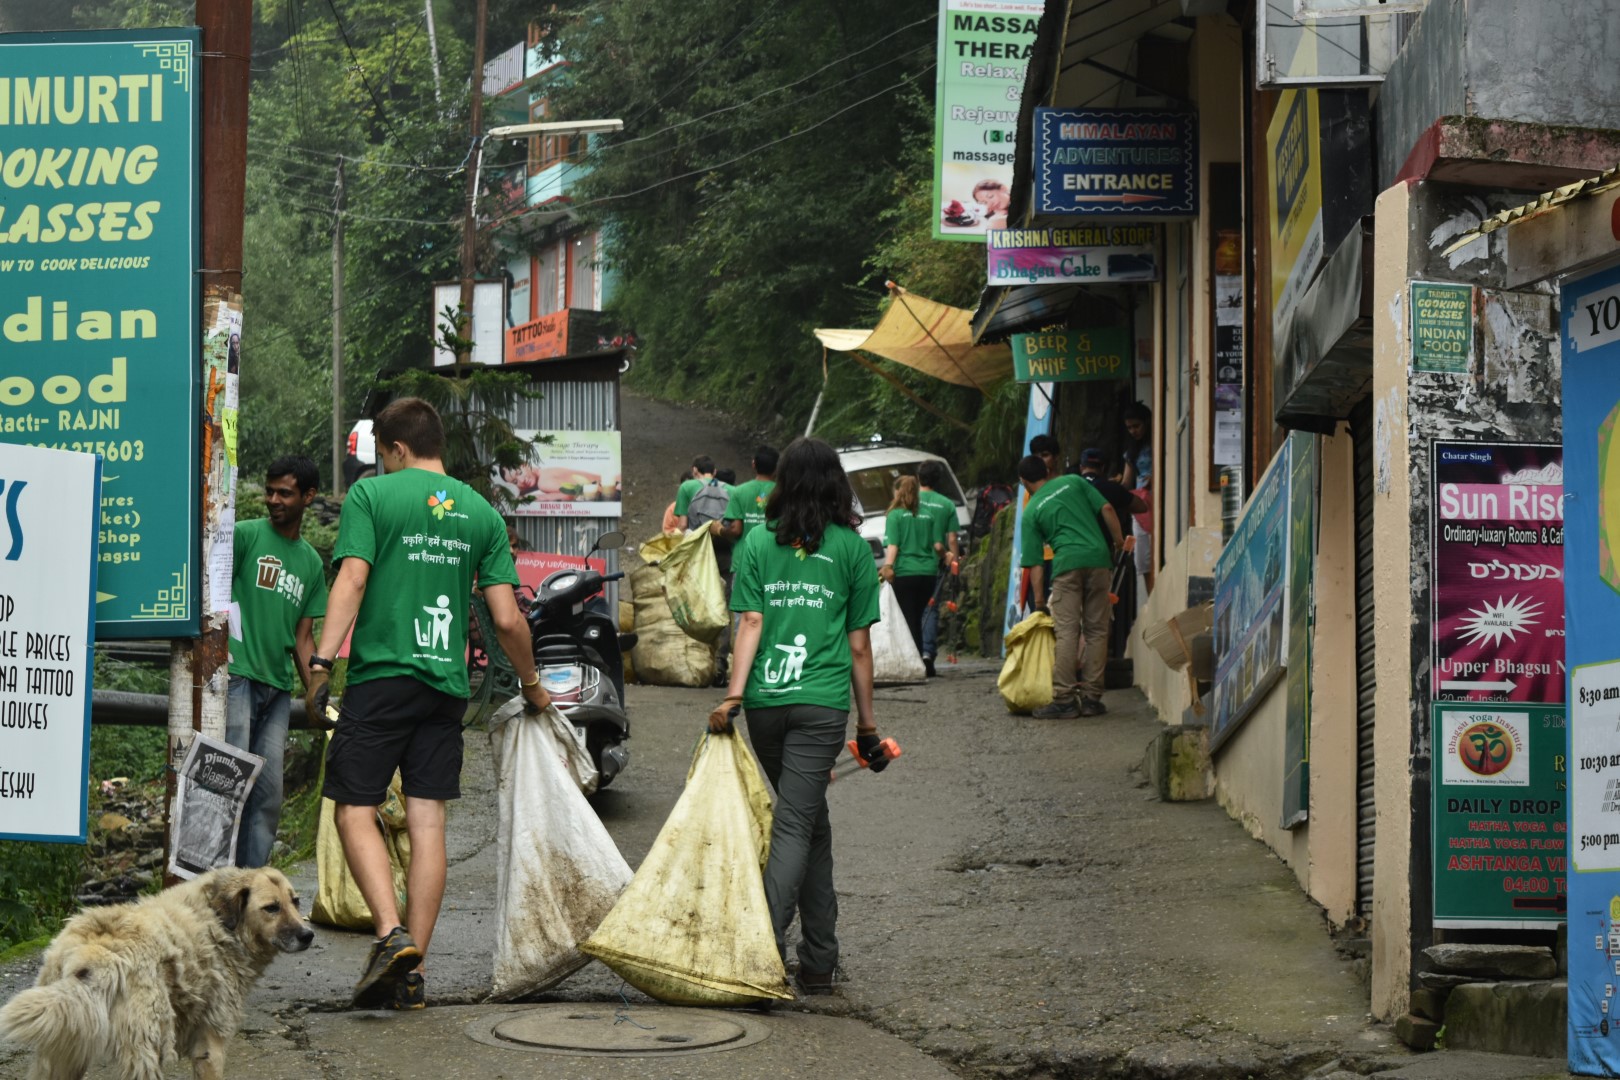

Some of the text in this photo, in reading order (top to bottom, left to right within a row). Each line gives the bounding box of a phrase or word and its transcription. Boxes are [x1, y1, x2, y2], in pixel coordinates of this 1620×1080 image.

[954, 14, 1038, 34] MASSA
[961, 62, 1022, 82] Relax,
[1006, 86, 1021, 100] &
[1060, 122, 1177, 140] HIMALAYAN
[1053, 147, 1182, 165] ADVENTURES
[0, 145, 158, 189] OKING
[1063, 174, 1174, 190] ENTRANCE
[993, 229, 1049, 248] KRISHNA
[1052, 228, 1109, 248] GENERAL
[18, 259, 34, 272] TO
[40, 258, 78, 272] COOK
[80, 256, 151, 270] DELICIOUS
[996, 254, 1100, 283] Bhagsu Cake
[1418, 298, 1466, 310] COOKING
[1420, 308, 1464, 320] CLASSES
[512, 321, 543, 346] TATTOO
[1419, 328, 1466, 341] INDIAN
[1026, 334, 1091, 355] BEER &
[1423, 340, 1462, 353] FOOD
[1028, 354, 1121, 377] WINE SHOP
[58, 409, 120, 431] RAJNI
[1442, 452, 1492, 462] Chatar Singh
[1441, 483, 1498, 520] Sun
[102, 510, 141, 528] ket)
[98, 530, 141, 547] Shop
[1508, 526, 1538, 544] Rooms
[1542, 527, 1548, 544] &
[26, 632, 70, 662] PRICES
[1440, 658, 1490, 677] Upper
[1494, 658, 1550, 678] Bhagsu
[26, 667, 74, 697] TATTOO
[1579, 686, 1602, 707] 8:30
[1448, 714, 1523, 754] Bhagsu Yoga Institute
[204, 752, 242, 777] Djumbey
[1580, 755, 1608, 773] 10:30
[202, 765, 234, 788] Classes
[1447, 798, 1562, 815] DAILY DROP
[1468, 820, 1510, 832] HATHA
[1514, 822, 1547, 832] YOGA
[1449, 838, 1564, 850] HATHA YOGA FLOW
[1580, 832, 1620, 851] 5:00 pm
[1447, 855, 1542, 872] ASHTANGA
[1503, 876, 1550, 892] 04:00
